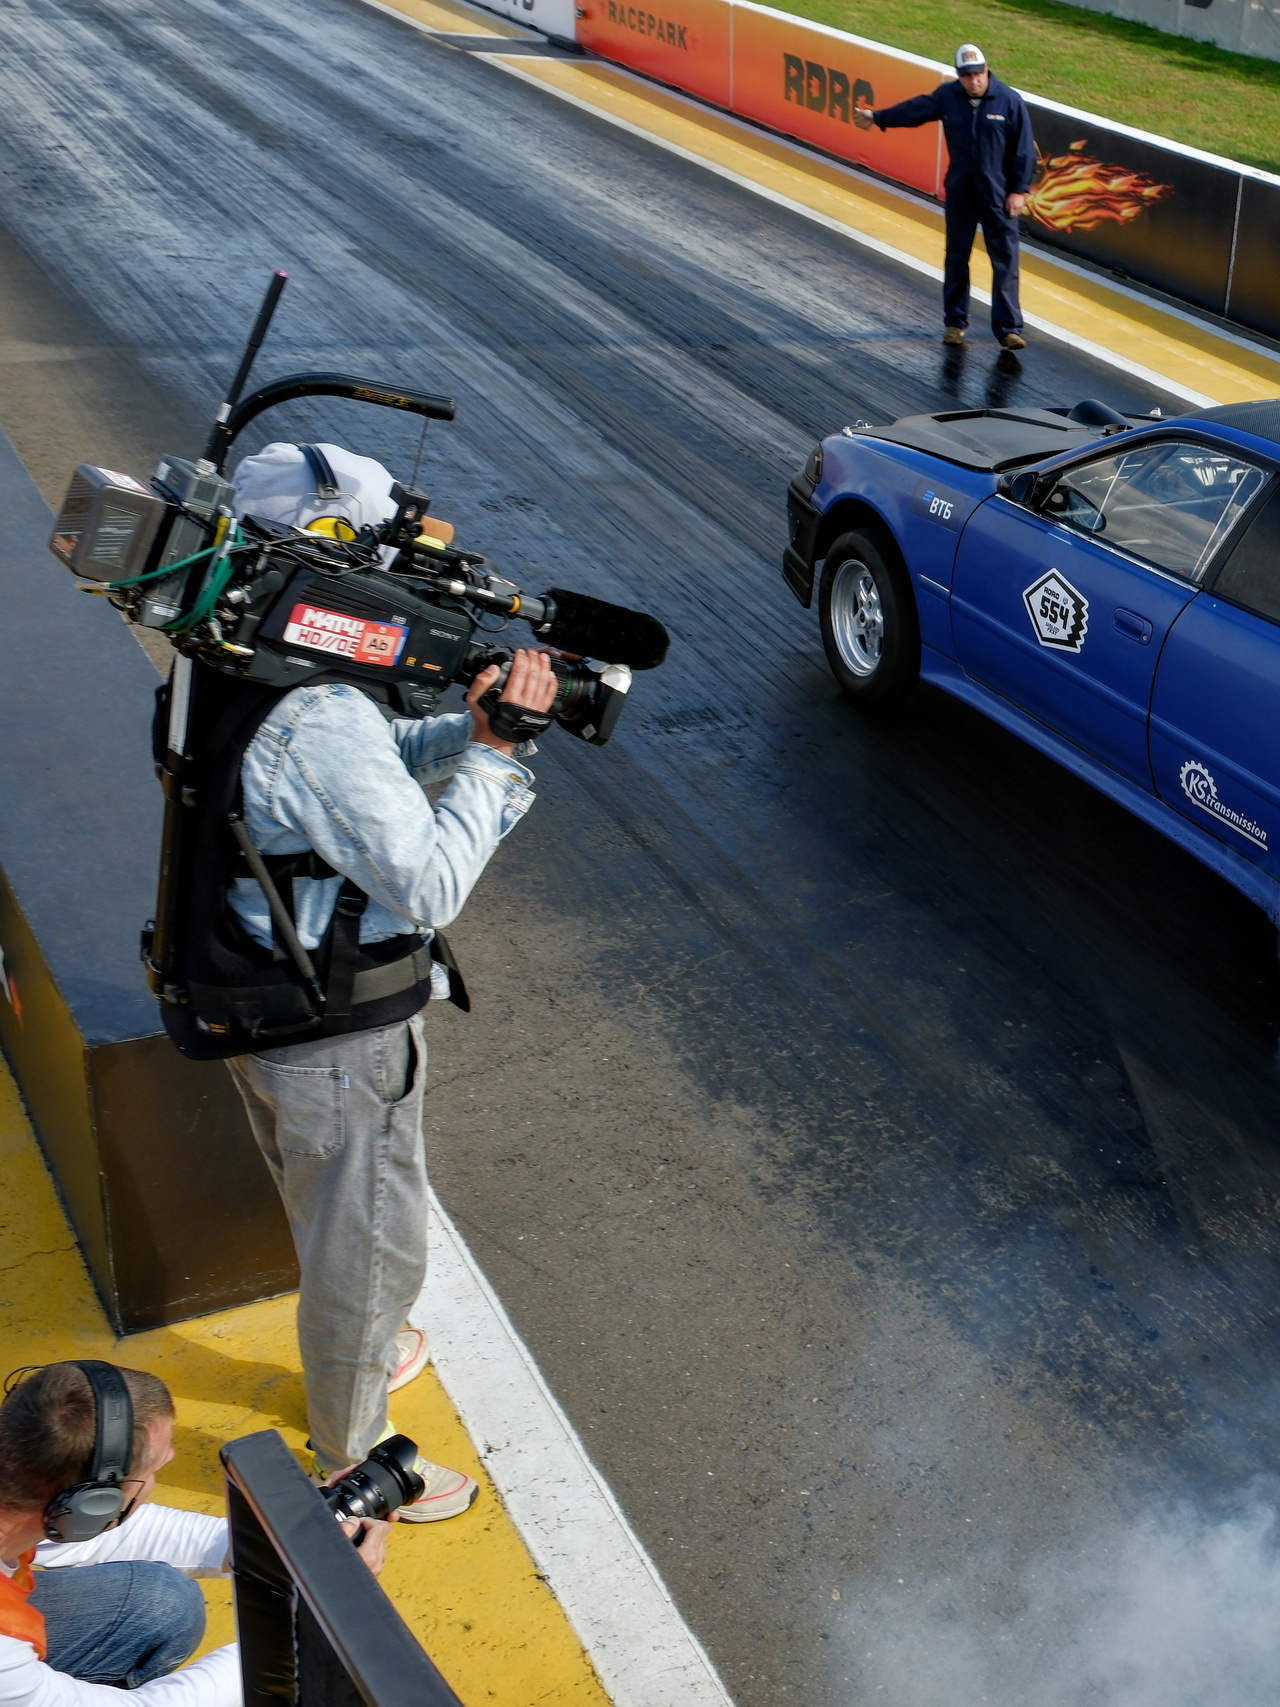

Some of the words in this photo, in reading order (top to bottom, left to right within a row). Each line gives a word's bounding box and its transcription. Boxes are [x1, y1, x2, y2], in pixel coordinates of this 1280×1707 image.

[607, 1, 689, 50] RACEPARK
[783, 52, 875, 132] RDRC
[929, 496, 954, 520] ВТБ
[1039, 594, 1070, 630] 554
